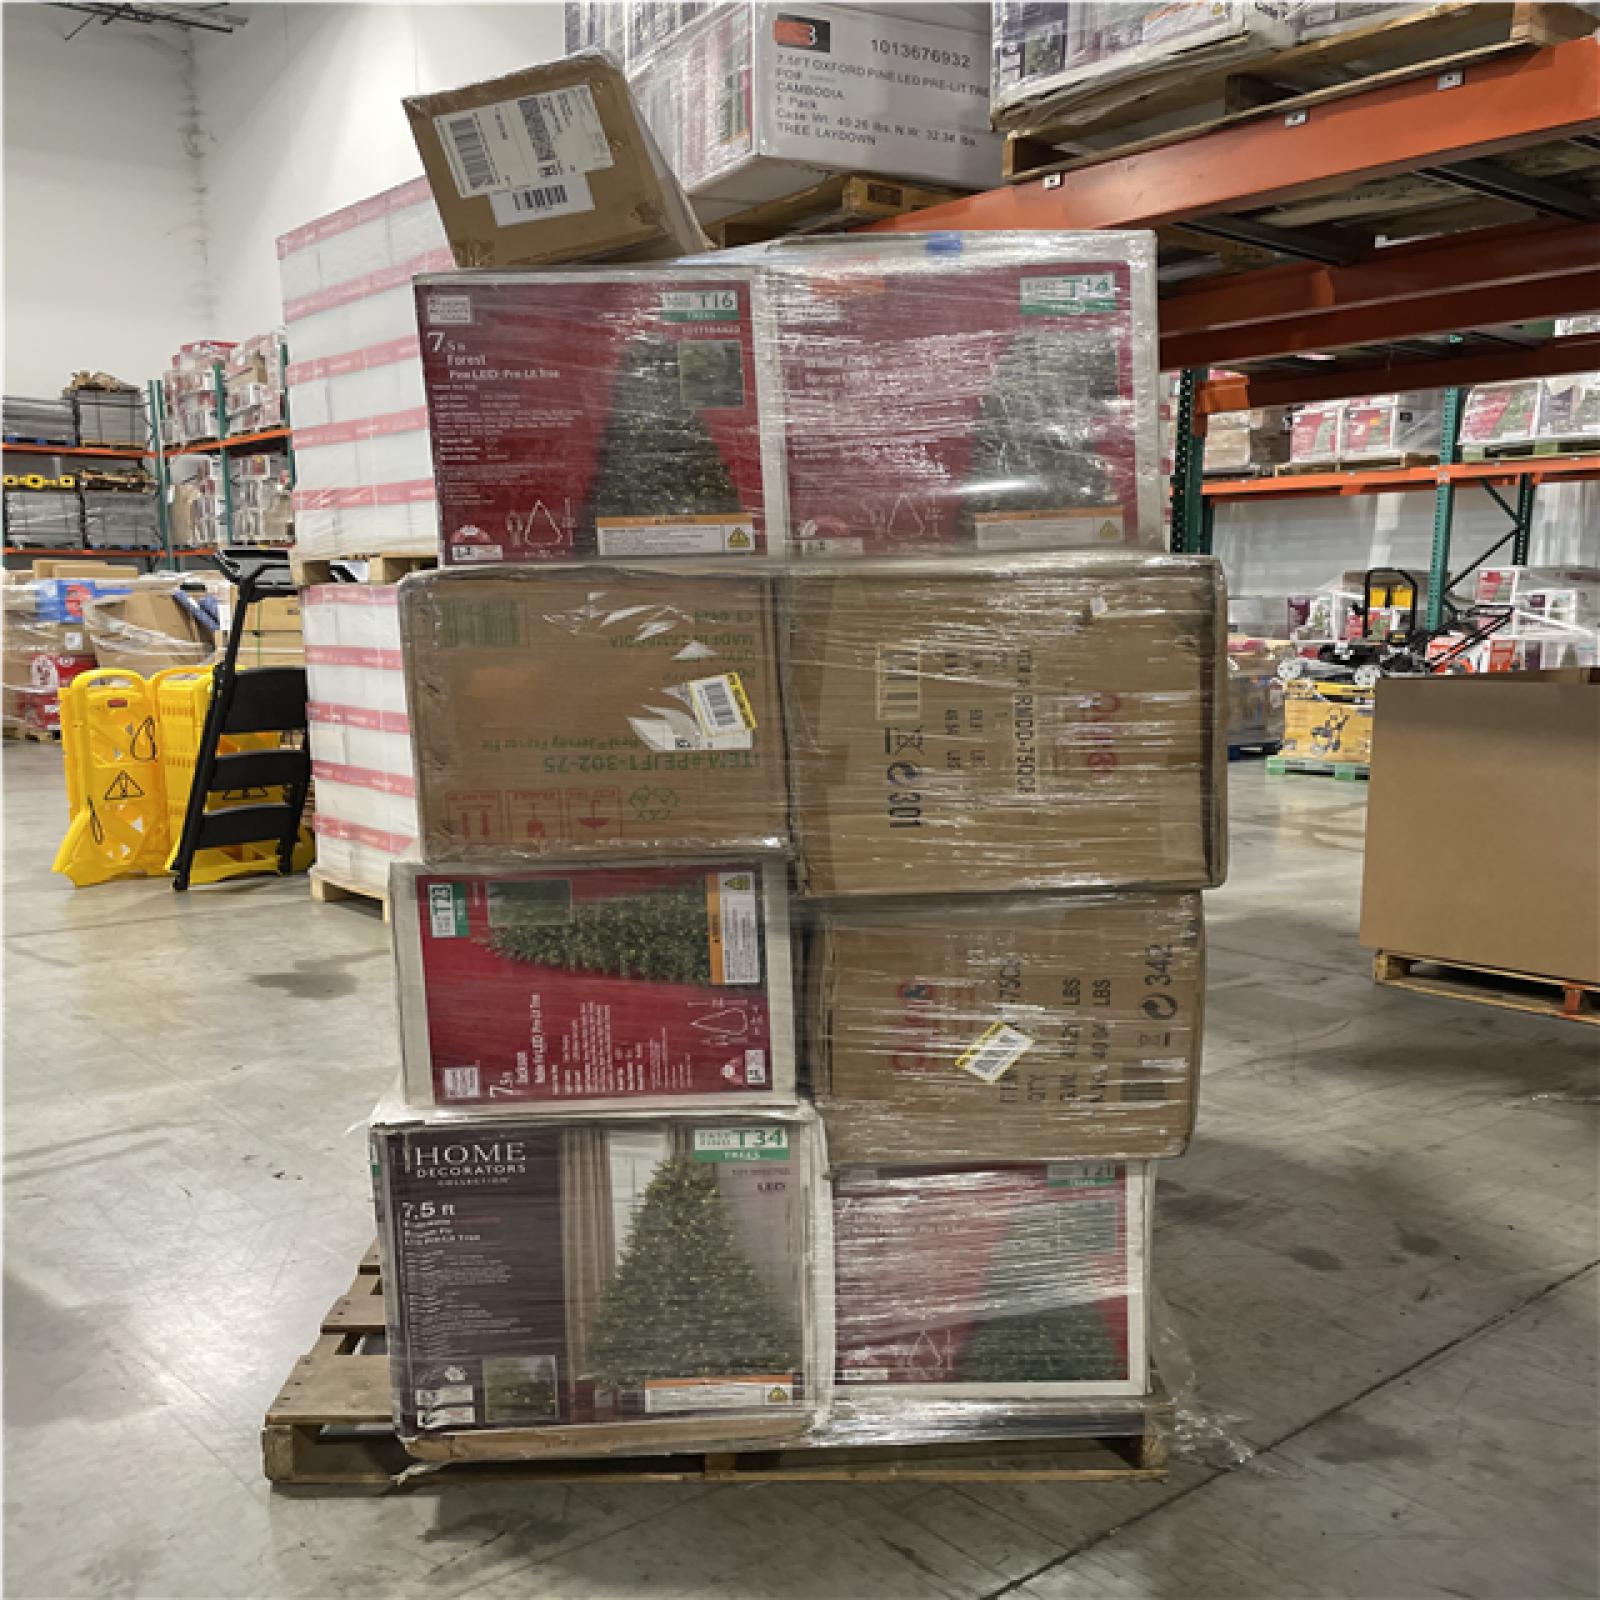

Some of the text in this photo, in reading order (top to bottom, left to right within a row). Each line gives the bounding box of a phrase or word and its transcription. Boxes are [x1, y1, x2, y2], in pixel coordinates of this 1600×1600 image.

[872, 39, 971, 69] 1013676932
[695, 290, 735, 310] T16
[1062, 976, 1081, 1006] LBS
[1092, 978, 1111, 1008] LBS
[732, 1128, 784, 1147] T34
[415, 1141, 526, 1166] HOME
[416, 1164, 526, 1178] DECORATORS
